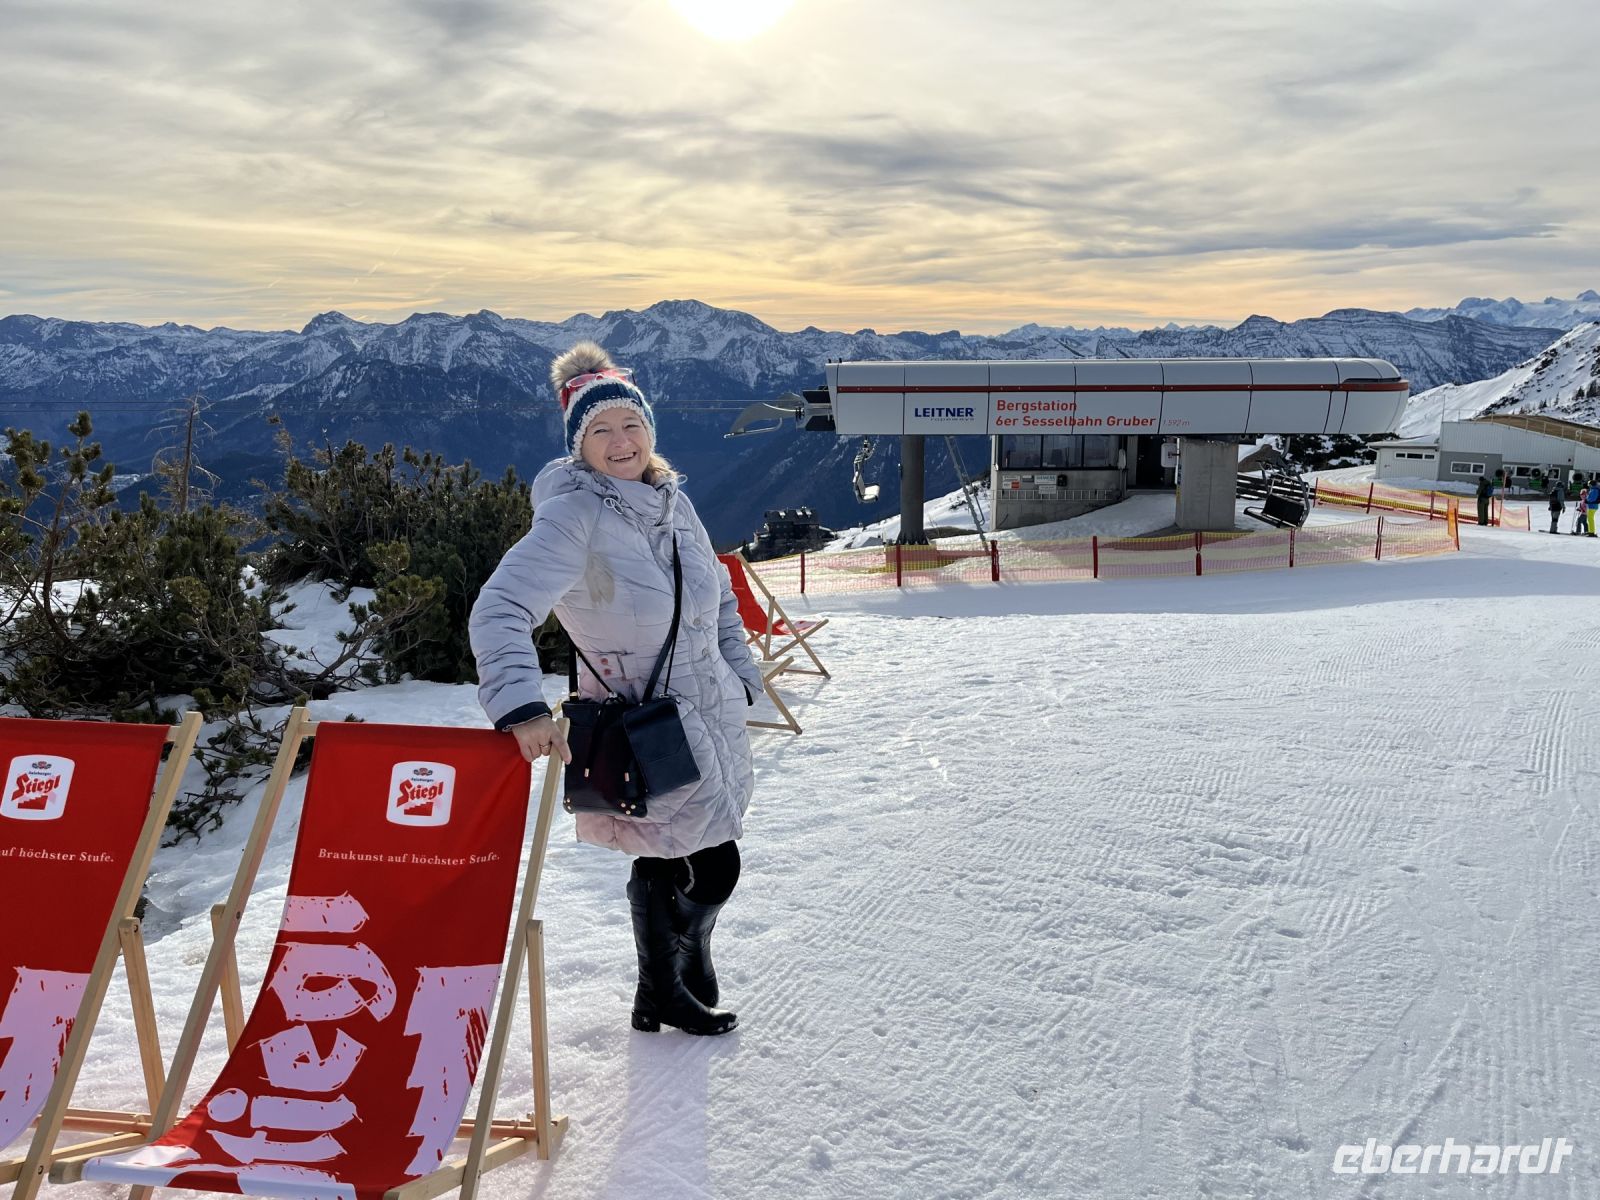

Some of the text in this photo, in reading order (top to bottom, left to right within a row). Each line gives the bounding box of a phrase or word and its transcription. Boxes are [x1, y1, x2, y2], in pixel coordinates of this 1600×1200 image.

[914, 407, 974, 418] LEITNER
[997, 399, 1077, 413] Bergstation
[996, 416, 1019, 427] 6er
[1022, 415, 1102, 427] Sesselbahn
[1106, 415, 1156, 427] Gruber
[11, 772, 62, 801] Stiegl
[396, 779, 445, 808] Stiegl
[0, 846, 115, 863] uf höchster Stufe.
[317, 848, 501, 866] Braukunst auf höchster Stufe.
